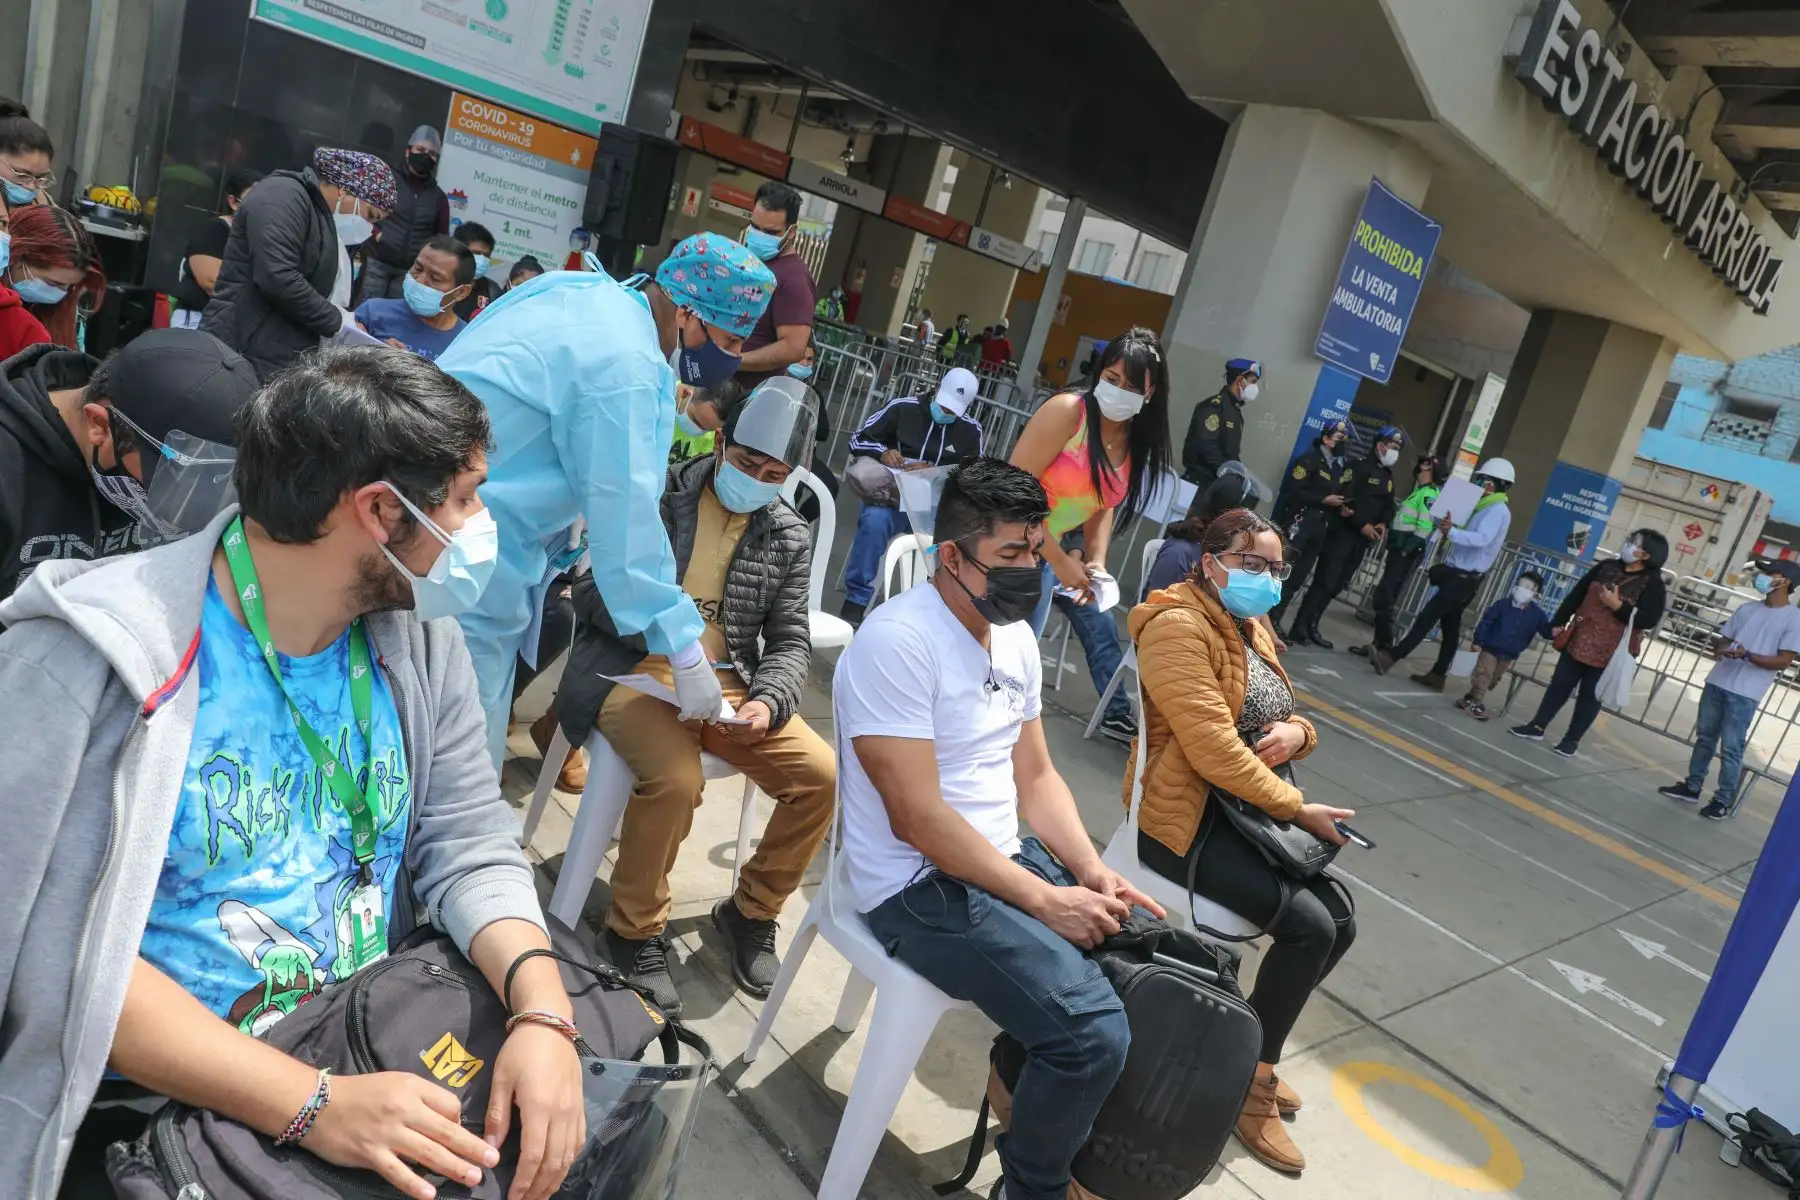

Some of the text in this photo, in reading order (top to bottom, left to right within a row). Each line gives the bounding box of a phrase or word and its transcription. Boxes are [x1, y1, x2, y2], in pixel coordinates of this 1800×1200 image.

[458, 116, 532, 148] CORONAVIRUS
[461, 100, 508, 125] COVID
[518, 121, 535, 136] 19
[454, 131, 547, 170] Por tu seguridad
[1533, 0, 1783, 310] ESTACION ARRIOLA
[473, 170, 578, 210] Mantener el metro
[489, 191, 557, 219] de distancia
[819, 175, 858, 198] ARRIOLA
[502, 220, 511, 234] 1
[1354, 219, 1424, 280] PROHIBIDA
[1351, 265, 1398, 306] LA VENTA
[1333, 286, 1402, 336] AMBULATORIA
[419, 1031, 485, 1088] CAT
[1088, 1133, 1192, 1190] didas
